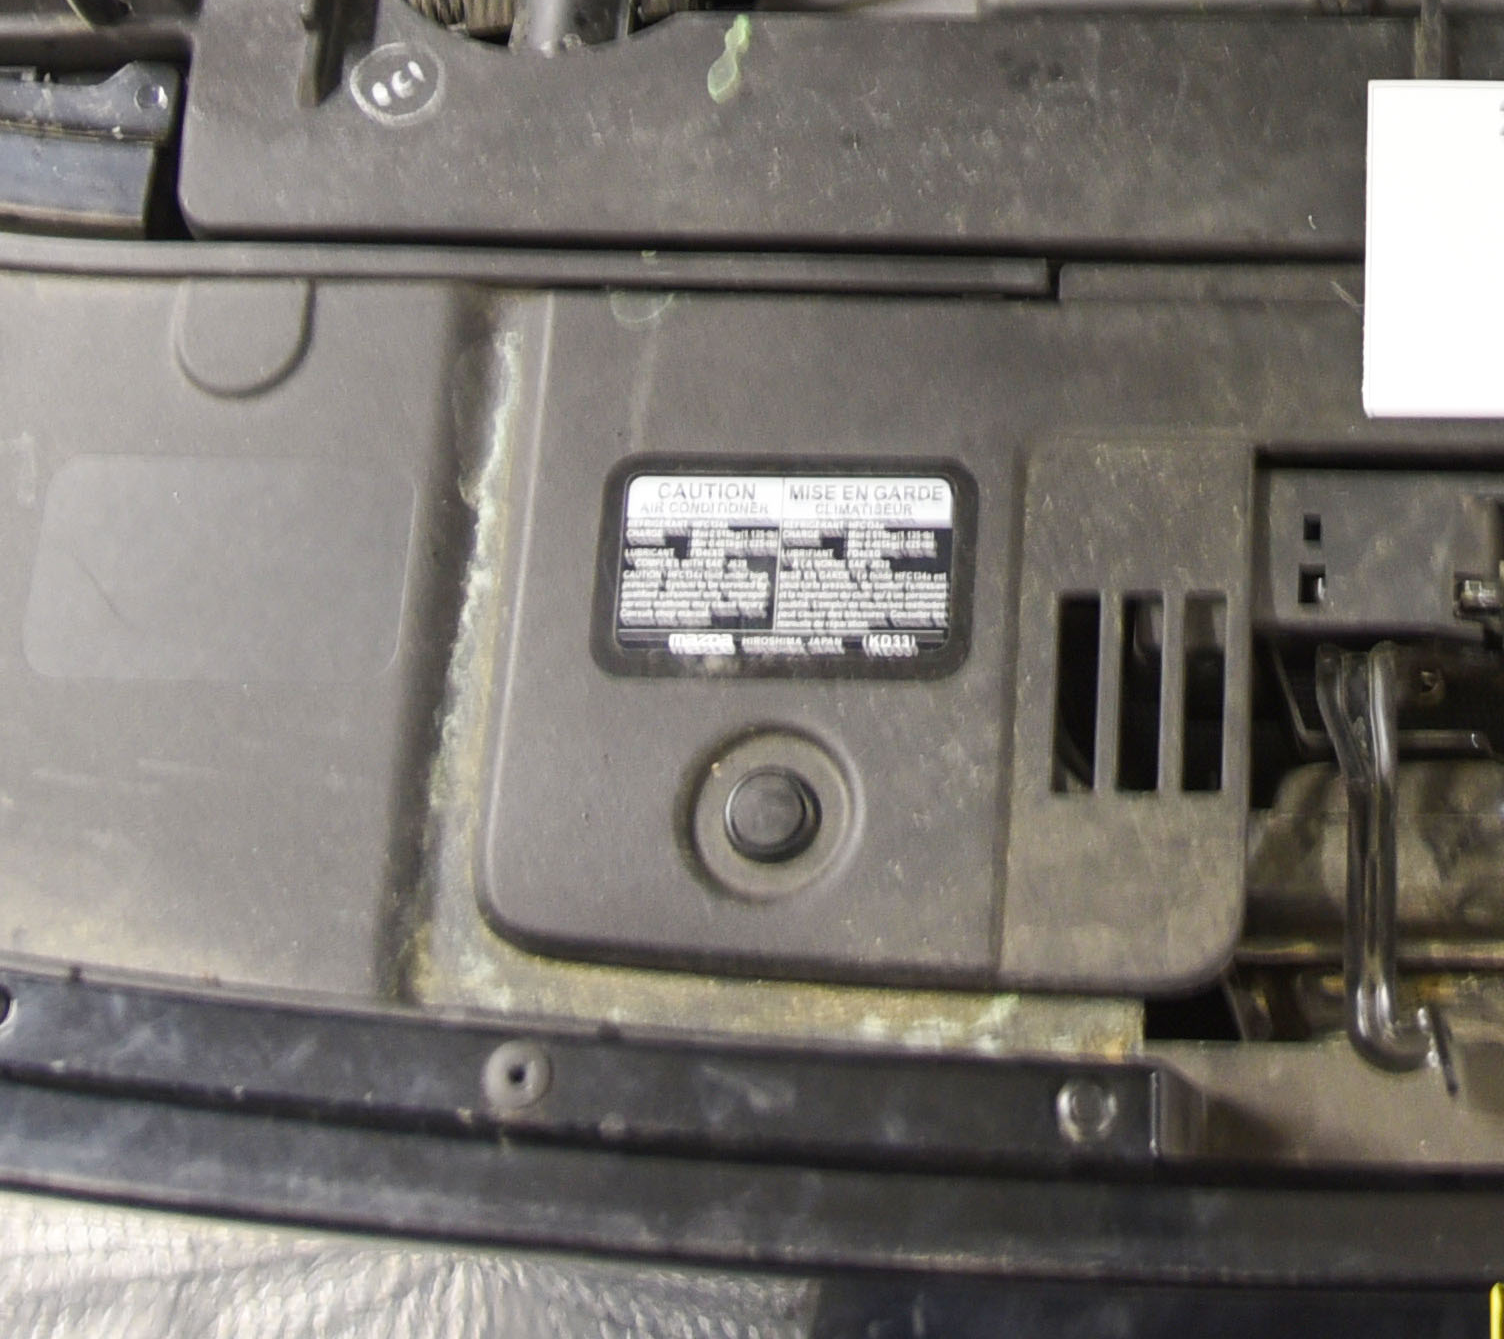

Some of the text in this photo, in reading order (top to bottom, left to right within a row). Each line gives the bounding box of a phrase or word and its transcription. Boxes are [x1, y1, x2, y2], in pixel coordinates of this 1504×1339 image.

[657, 482, 756, 499] CAUTION
[788, 484, 944, 501] MISE EN GARDE
[640, 501, 769, 515] AIR CONDITIONER
[815, 503, 913, 516] CLIMATISEUR
[807, 637, 844, 652] JAPAN
[861, 633, 918, 653] (KD33)
